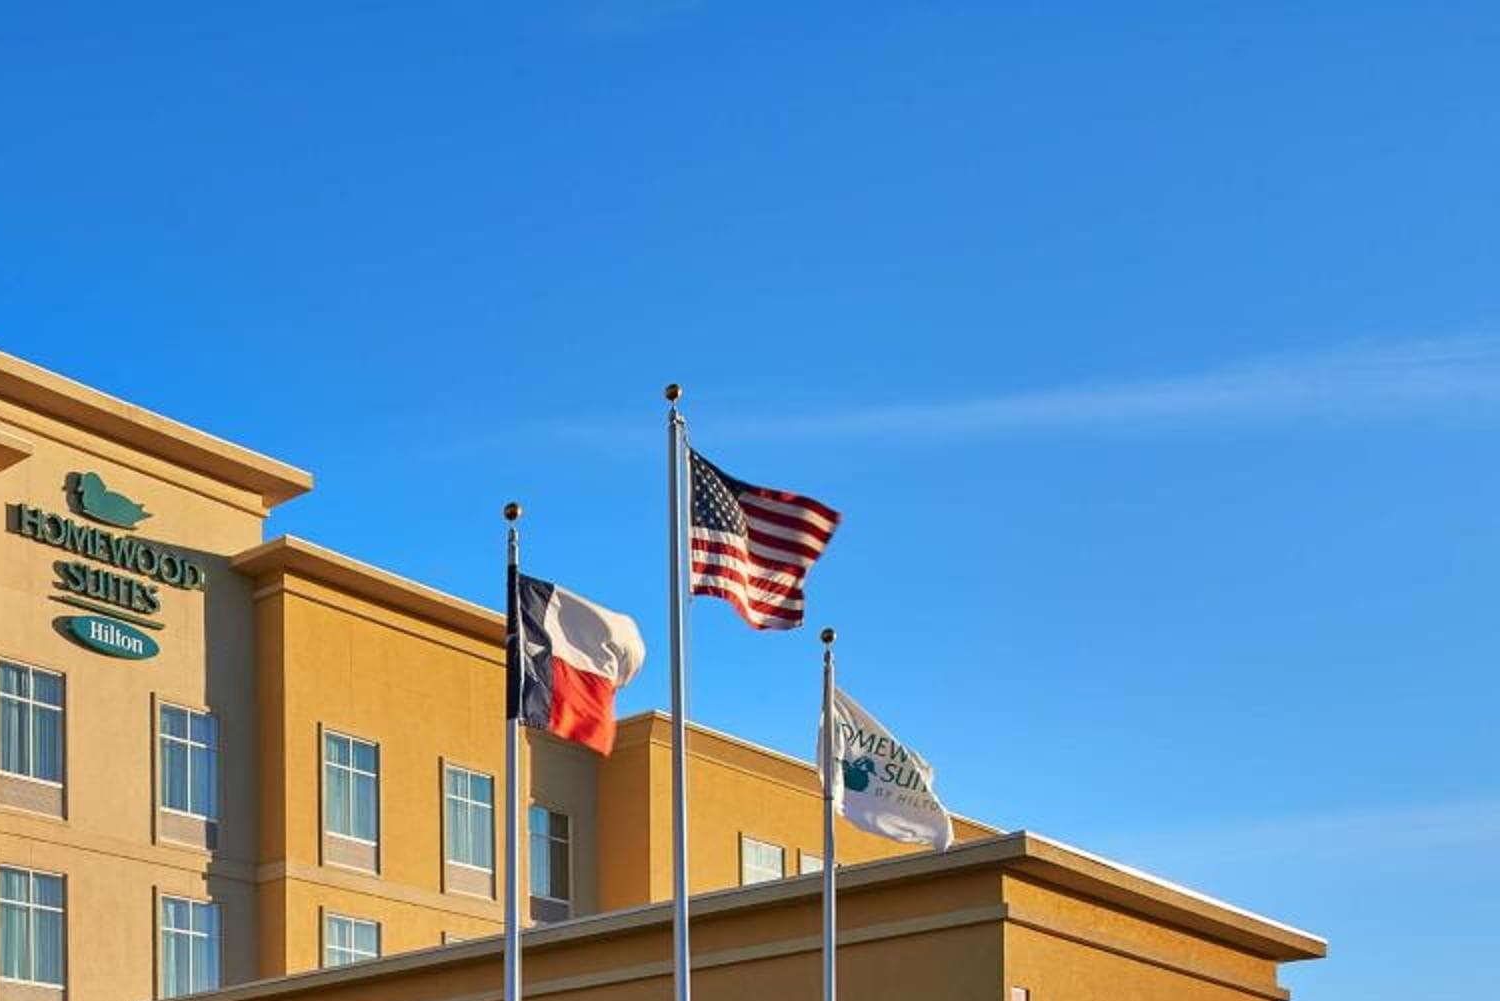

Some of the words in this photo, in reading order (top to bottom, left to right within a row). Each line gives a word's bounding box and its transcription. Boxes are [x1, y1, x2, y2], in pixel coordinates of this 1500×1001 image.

[17, 502, 206, 592] HOMEWOOD
[60, 560, 161, 615] SUITES
[88, 620, 144, 655] Hilton
